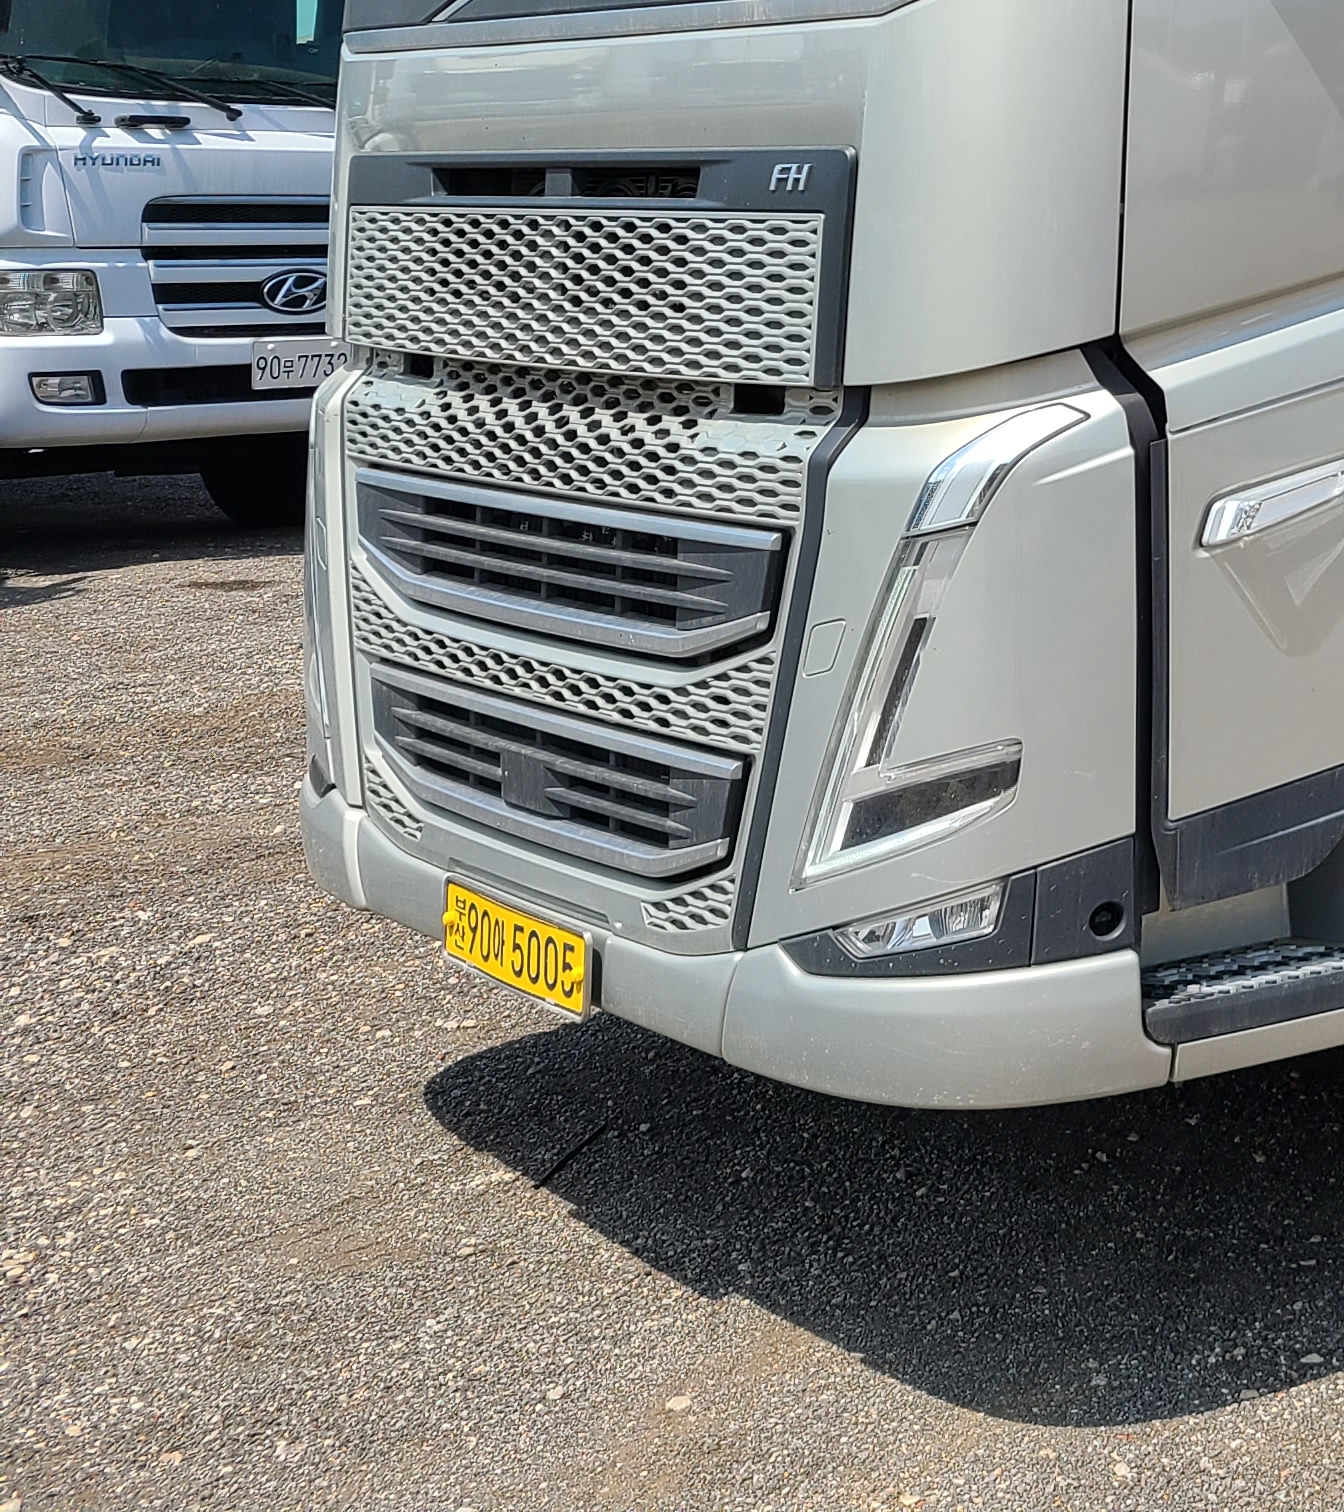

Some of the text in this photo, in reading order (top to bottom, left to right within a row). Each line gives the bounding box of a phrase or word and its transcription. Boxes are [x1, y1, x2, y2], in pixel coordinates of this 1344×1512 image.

[73, 152, 161, 167] HYUNDAI
[768, 162, 814, 191] FH
[455, 895, 467, 951] 부산
